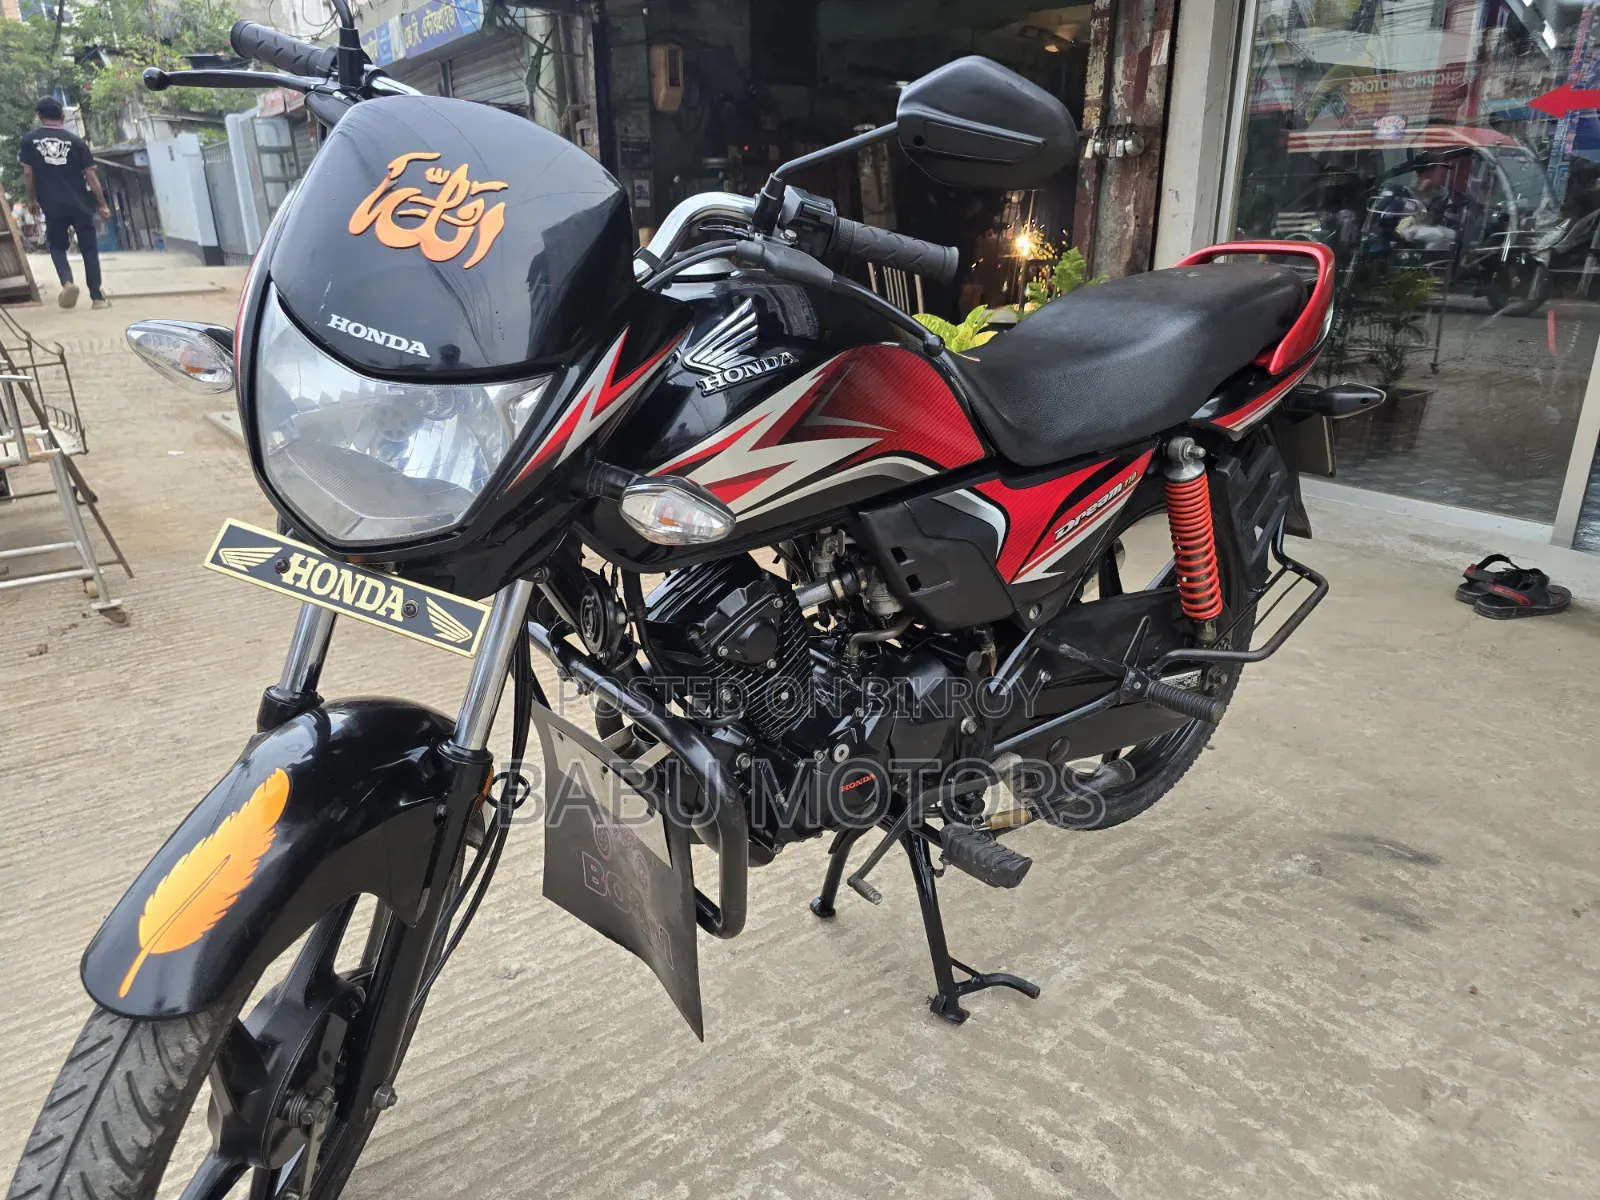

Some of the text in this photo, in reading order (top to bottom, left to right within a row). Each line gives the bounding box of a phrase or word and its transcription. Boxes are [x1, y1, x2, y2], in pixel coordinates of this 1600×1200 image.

[327, 313, 430, 358] HONDA
[698, 351, 799, 395] HONDA
[1054, 482, 1123, 541] Dream
[280, 551, 405, 623] HONDA
[840, 772, 876, 792] HONDA
